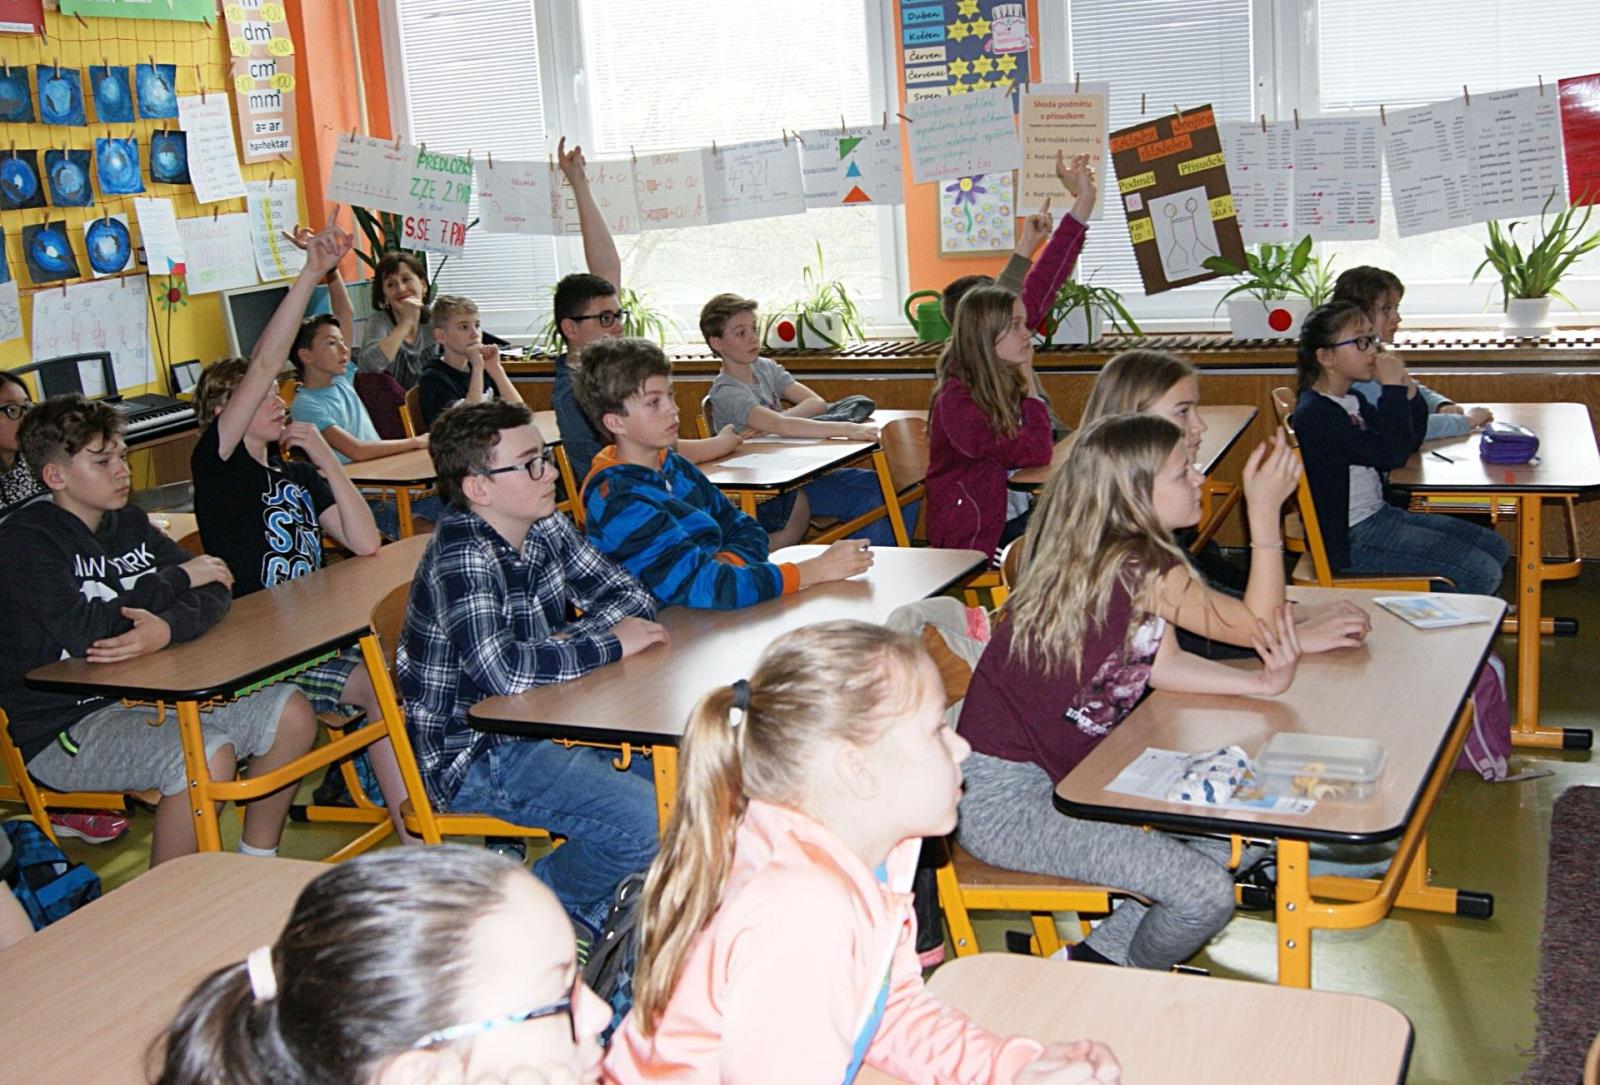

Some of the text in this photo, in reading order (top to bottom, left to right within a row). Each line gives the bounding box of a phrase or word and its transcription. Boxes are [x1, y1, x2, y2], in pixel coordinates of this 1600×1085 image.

[908, 9, 940, 20] Duben
[909, 31, 941, 41] Květen
[909, 50, 942, 61] Červen
[908, 70, 945, 80] Červenec
[914, 92, 942, 102] Srpen
[1033, 100, 1092, 109] Shoda podmětu
[1045, 111, 1085, 121] přísudkem
[1181, 154, 1223, 173] Přísudek
[1119, 175, 1154, 191] Podmět
